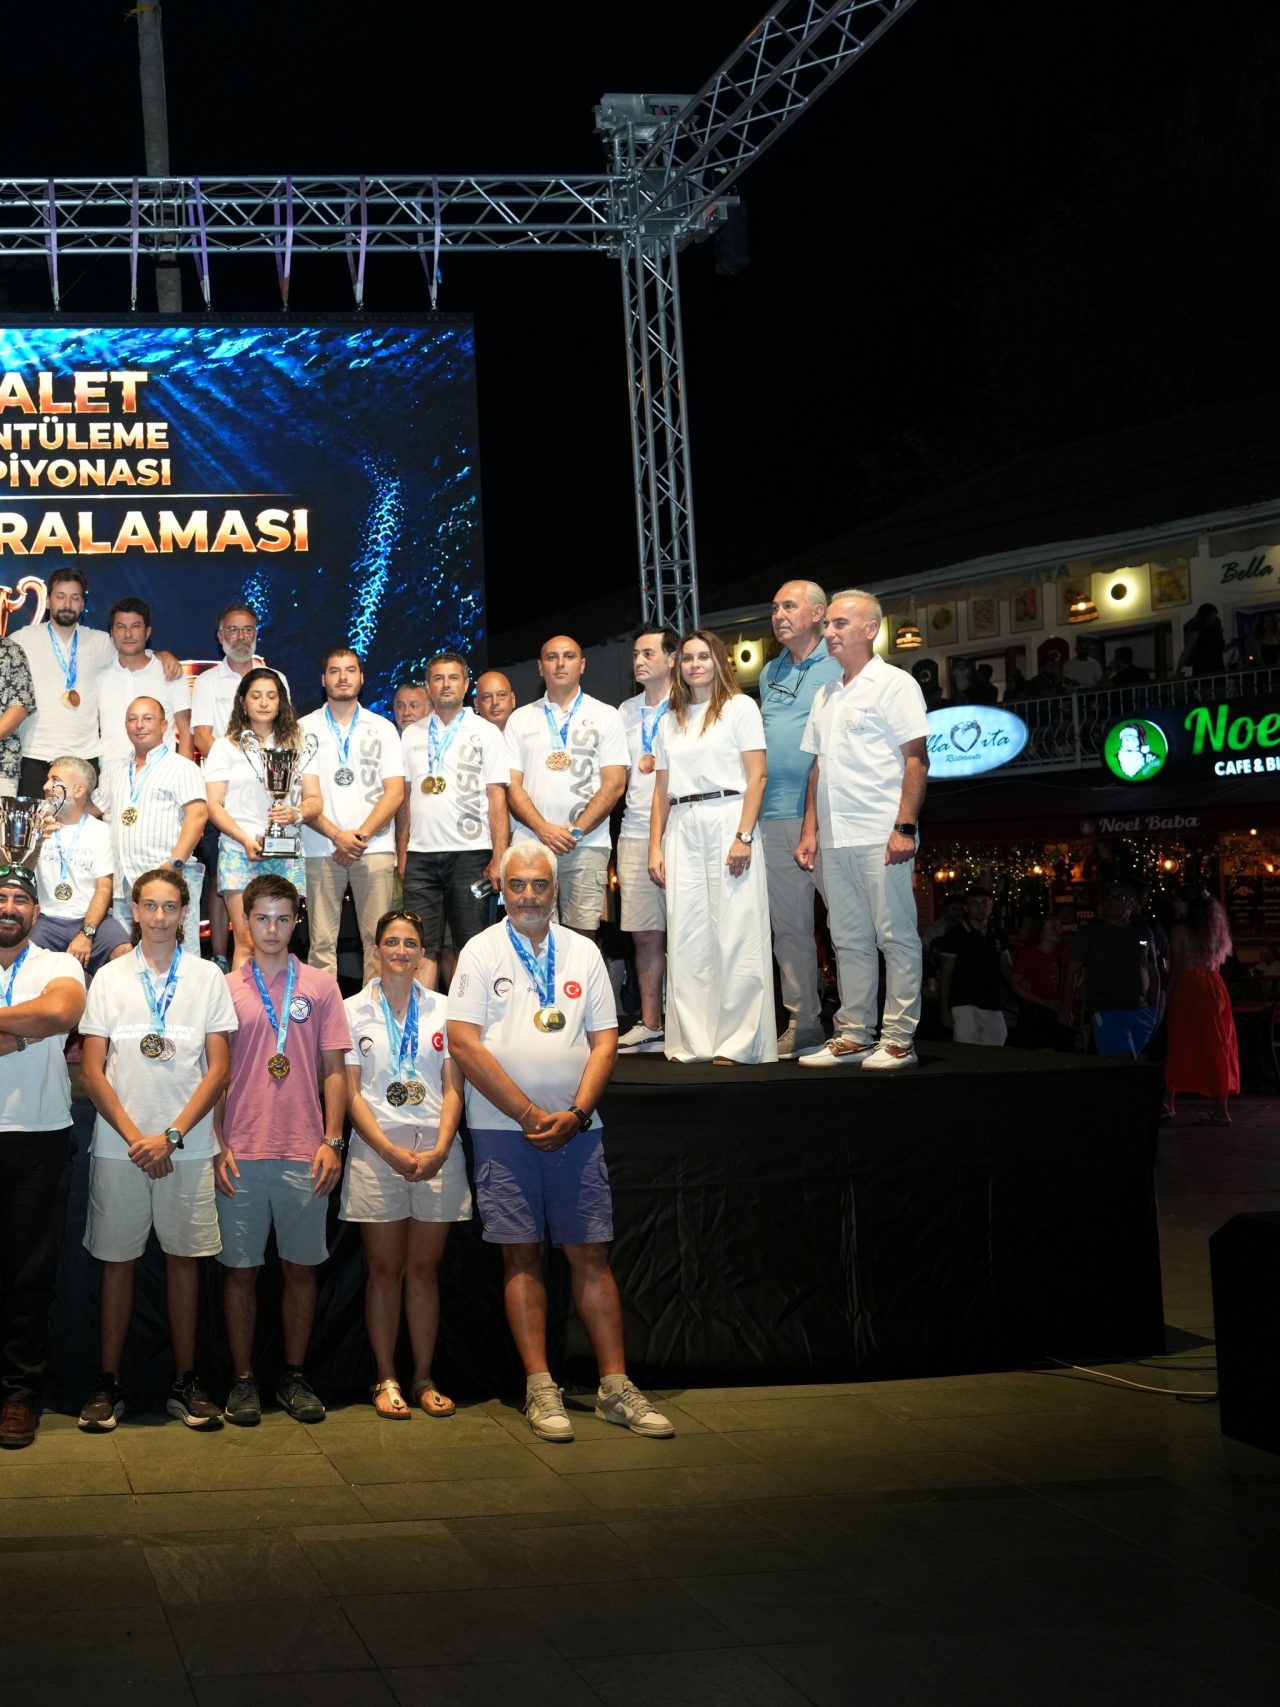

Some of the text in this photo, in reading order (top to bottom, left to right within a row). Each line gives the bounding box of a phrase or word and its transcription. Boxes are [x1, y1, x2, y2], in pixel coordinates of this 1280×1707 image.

[1220, 554, 1274, 584] Bella
[926, 734, 950, 753] lla
[1214, 759, 1253, 776] CAFE
[1253, 757, 1265, 773] &
[1099, 814, 1201, 833] Noel Baba
